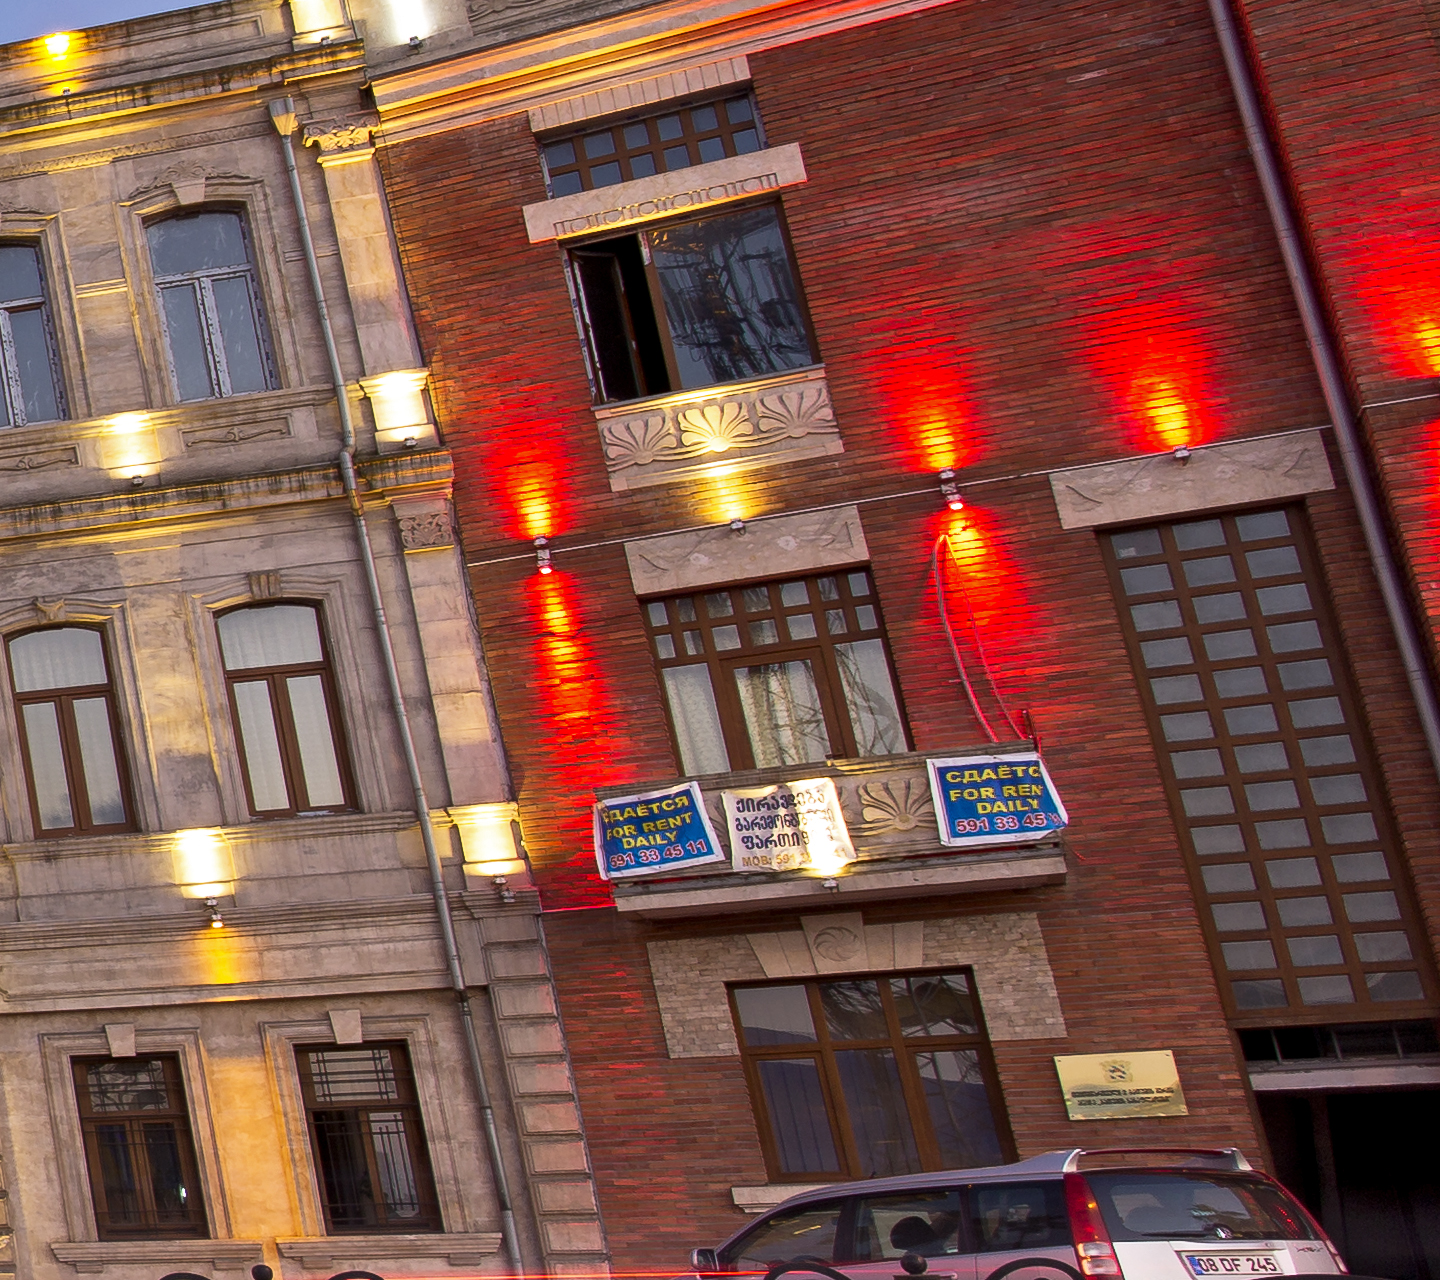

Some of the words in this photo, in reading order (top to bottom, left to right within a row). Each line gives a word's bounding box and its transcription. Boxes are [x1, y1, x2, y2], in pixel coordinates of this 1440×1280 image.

[946, 765, 1040, 784] СДАЁТС
[949, 787, 996, 802] FOR
[1002, 784, 1043, 797] REN
[976, 798, 1039, 814] DAILY
[607, 825, 637, 841] FOR
[642, 812, 693, 833] RENT
[955, 817, 989, 833] 591
[994, 815, 1019, 830] 33
[1022, 812, 1046, 827] 45
[622, 831, 678, 849] DAILY
[610, 852, 635, 868] 591
[639, 849, 660, 863] 33
[664, 844, 684, 858] 45
[686, 839, 707, 854] 11
[1197, 1257, 1219, 1272] 08
[1219, 1257, 1241, 1272] DF
[1246, 1258, 1277, 1272] 245
